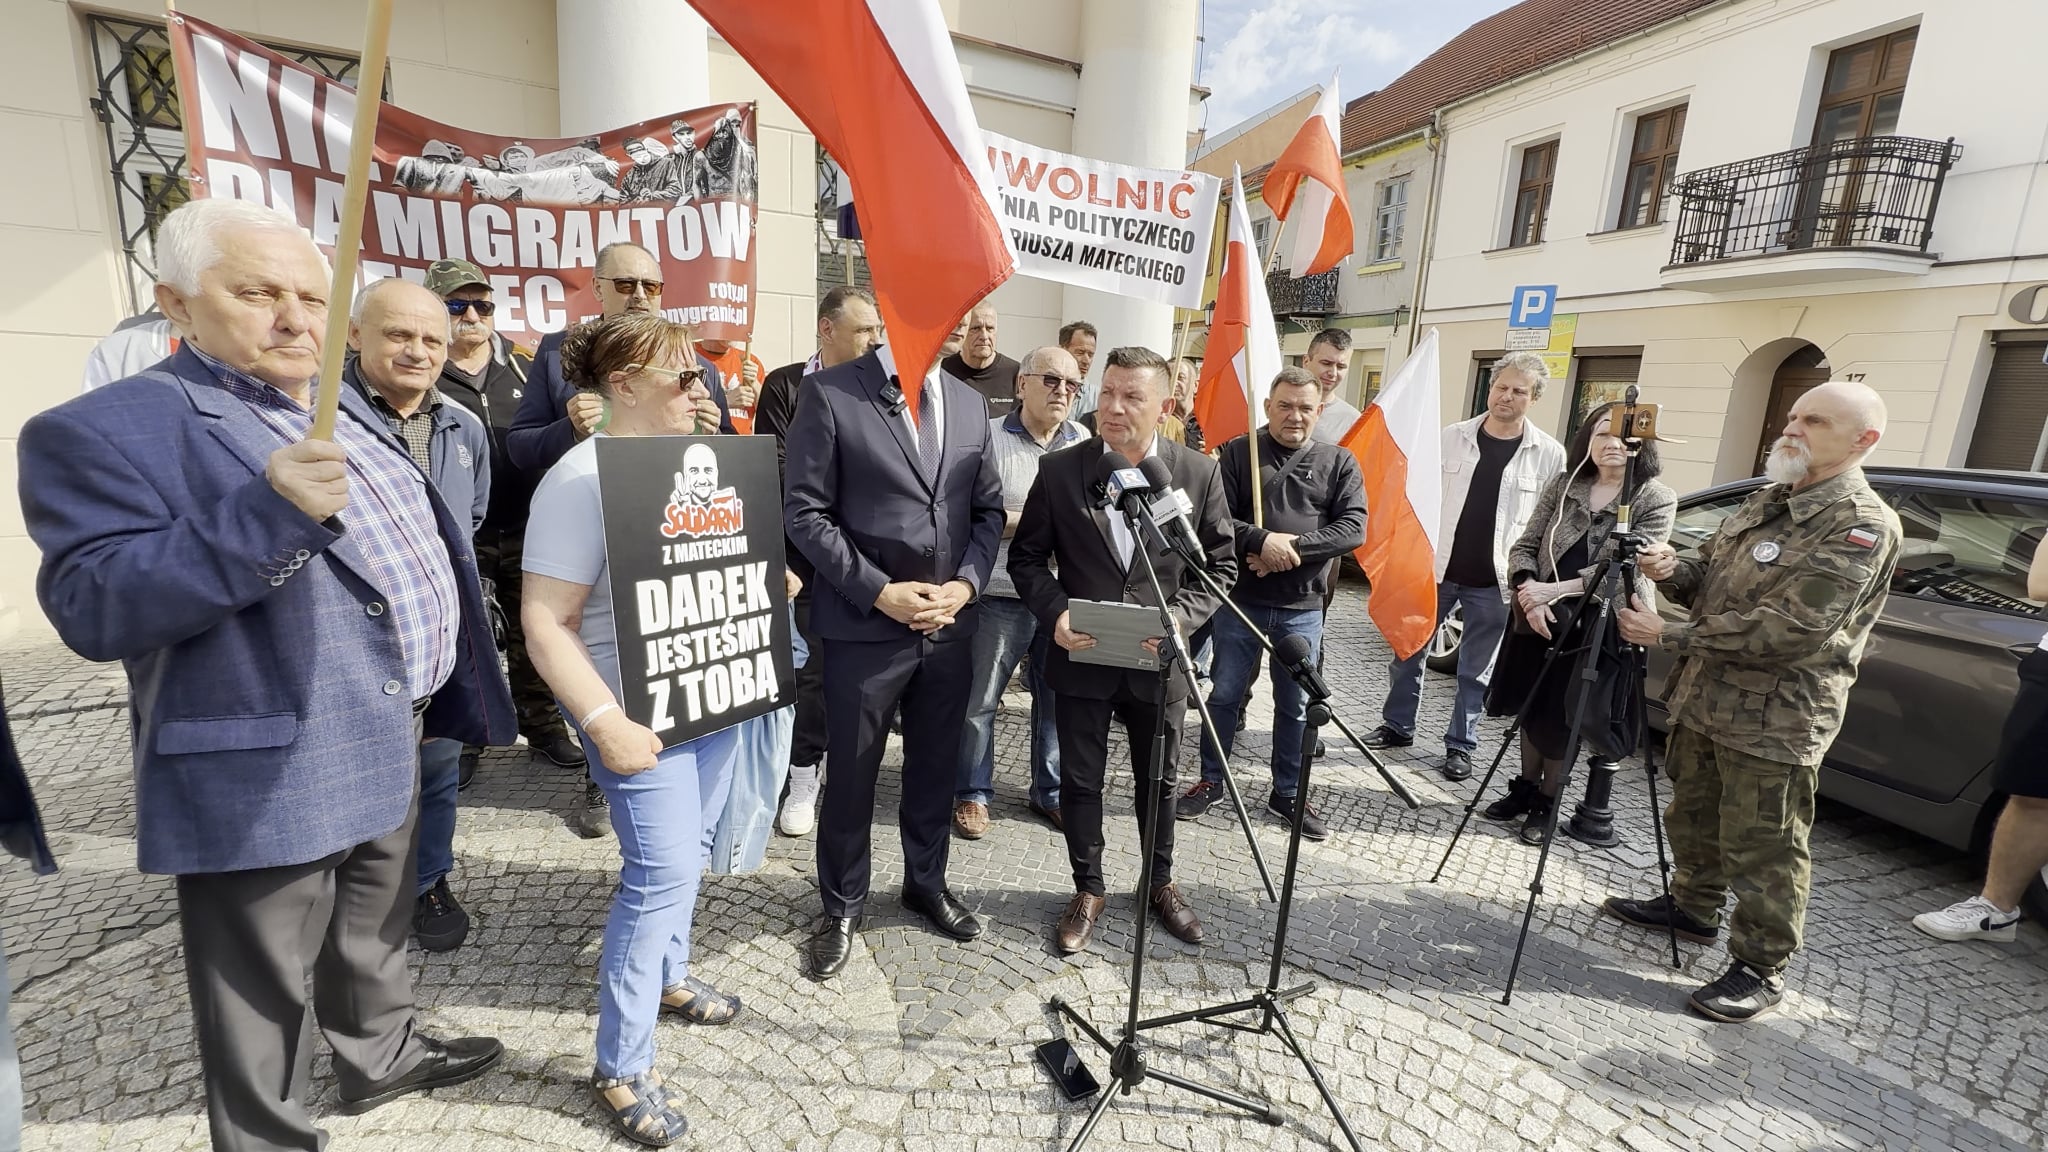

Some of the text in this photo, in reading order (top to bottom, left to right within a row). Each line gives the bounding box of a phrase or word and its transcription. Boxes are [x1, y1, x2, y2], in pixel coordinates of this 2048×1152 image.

[372, 194, 750, 269] MIGRANTÓW
[998, 186, 1195, 254] NIA POLITYCZNEGO
[1010, 228, 1186, 286] RIUSZA MATECKIEGO
[1518, 290, 1547, 323] P
[662, 535, 749, 565] Z MATECKIM
[635, 561, 772, 635] DAREK
[645, 614, 772, 677] JESTEŚMY
[647, 650, 780, 732] Z TOBĄ
